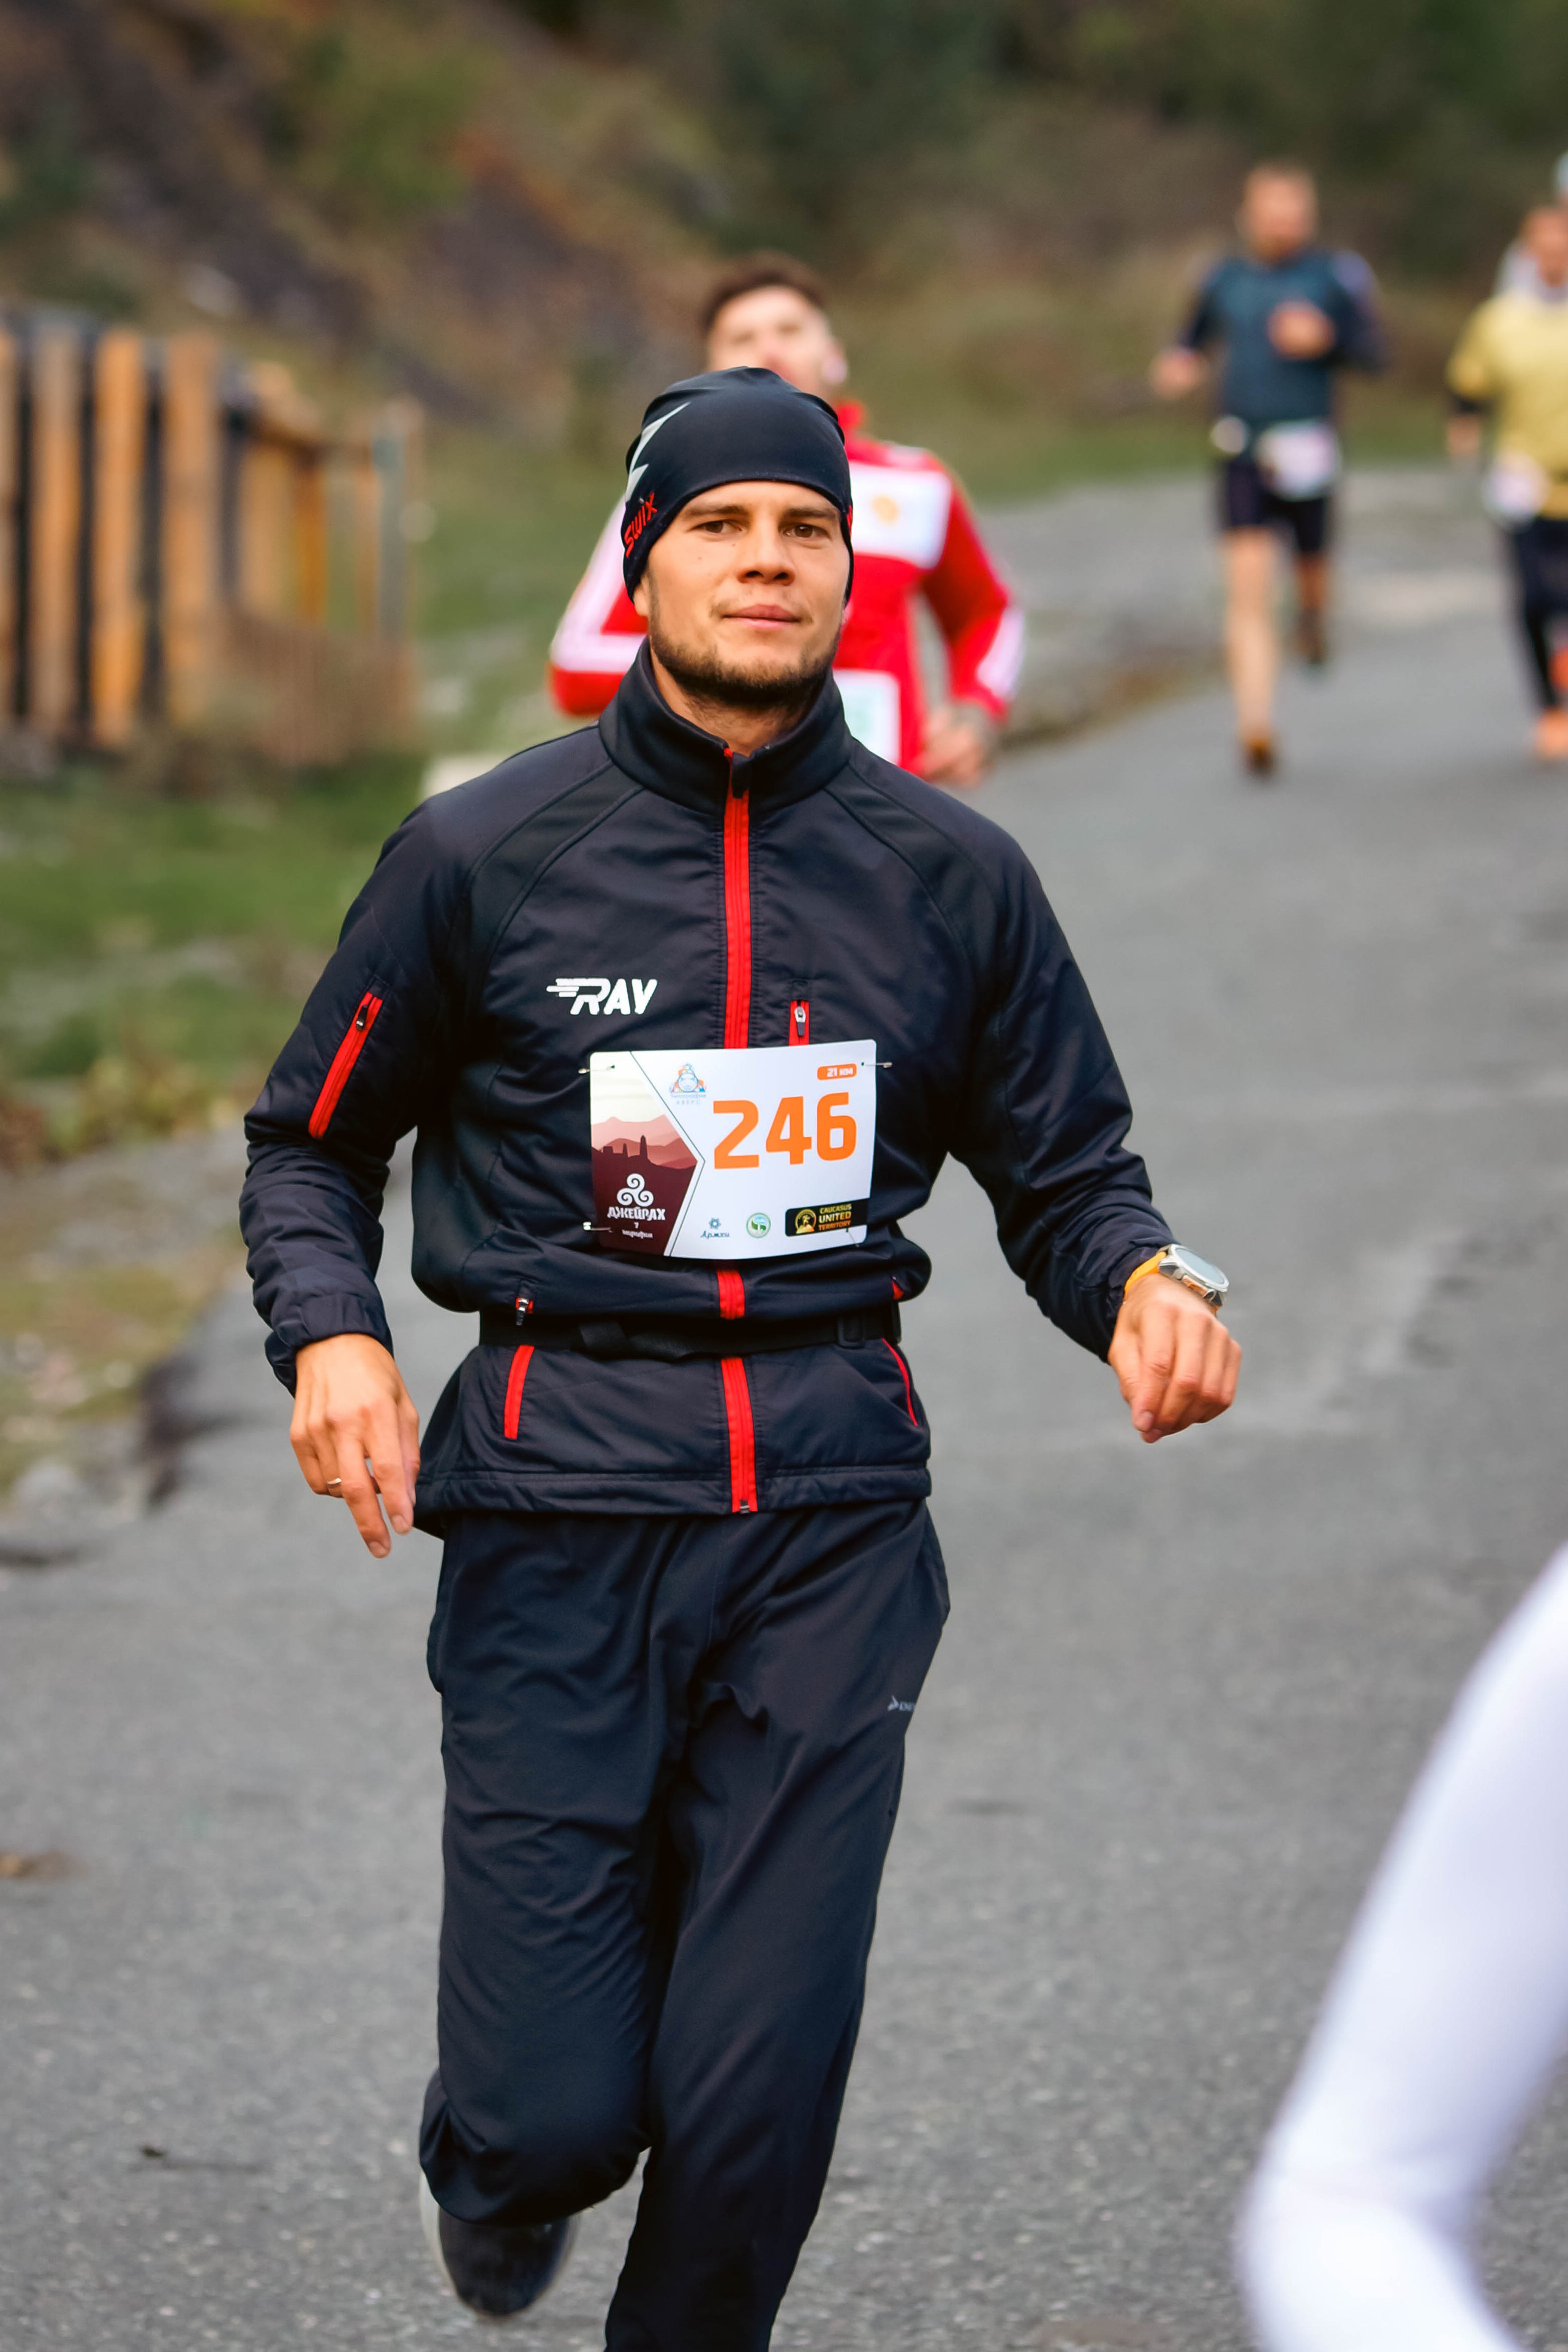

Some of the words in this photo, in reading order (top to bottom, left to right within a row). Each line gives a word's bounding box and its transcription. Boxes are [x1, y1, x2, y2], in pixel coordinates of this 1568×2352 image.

[546, 978, 658, 1016] RAV
[827, 1068, 838, 1077] 21
[713, 1091, 857, 1169] 246
[607, 1207, 666, 1221] ДЖЕЙРАХ
[820, 1204, 852, 1214] CAUCASUS
[818, 1211, 851, 1223] UNITED
[818, 1220, 851, 1231] TERRITORY
